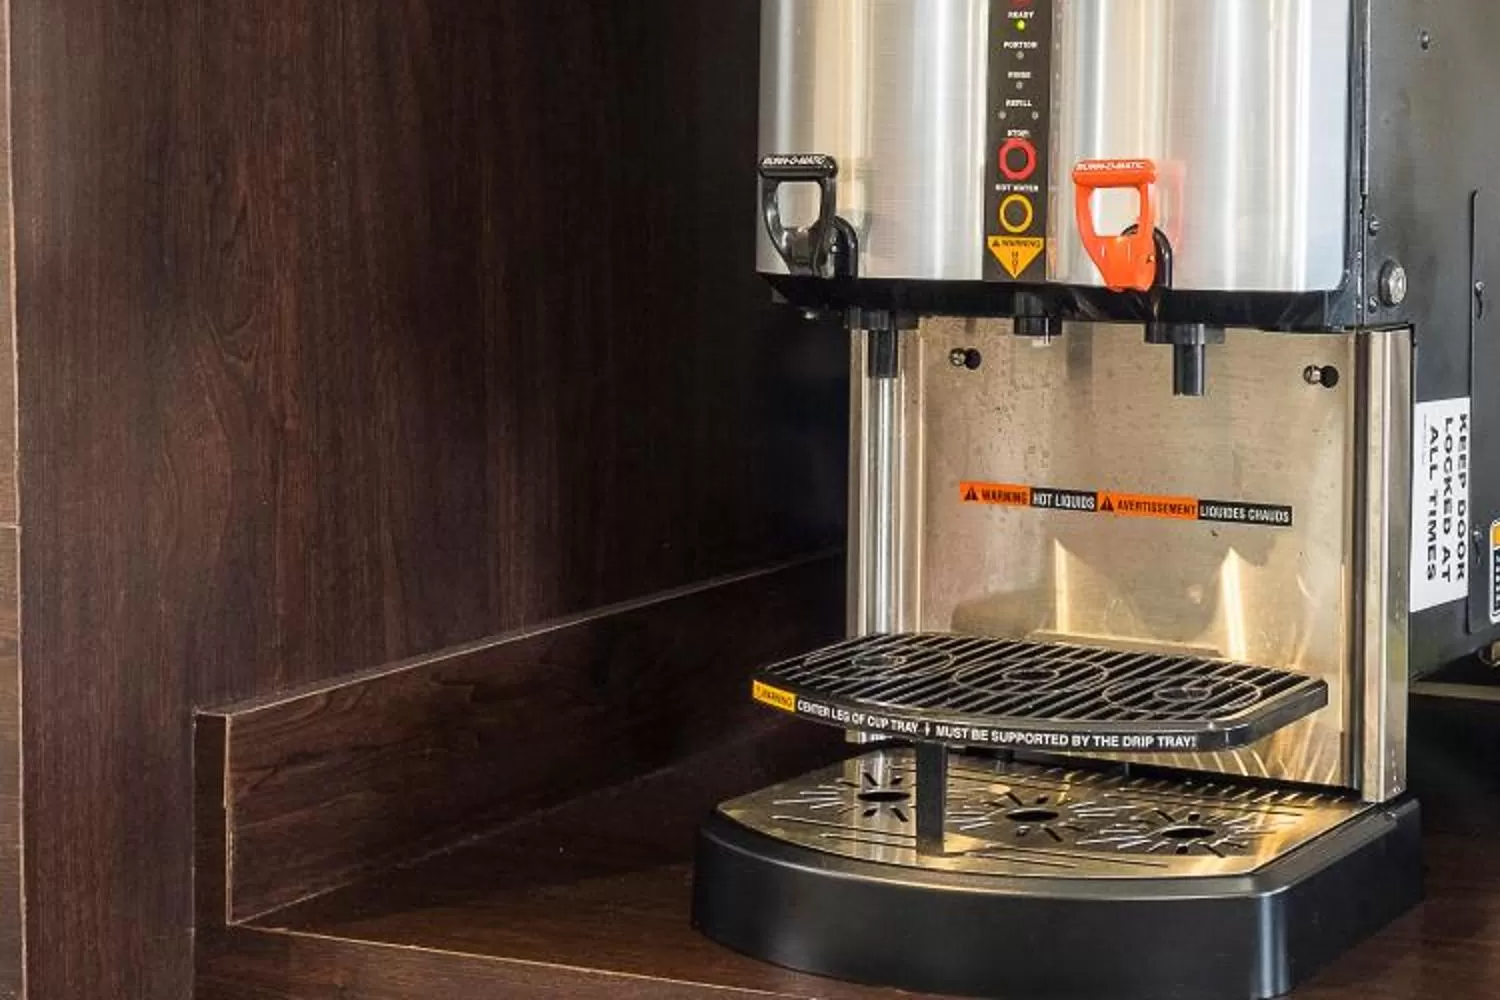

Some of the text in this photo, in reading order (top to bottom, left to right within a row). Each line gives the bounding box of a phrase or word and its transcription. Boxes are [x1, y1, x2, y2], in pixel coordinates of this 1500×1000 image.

[1007, 11, 1035, 19] READY
[1003, 41, 1038, 49] PORTION
[1005, 99, 1032, 107] REFILL
[1013, 184, 1039, 193] WATER
[1002, 239, 1040, 248] WARNING
[981, 488, 1290, 523] WARNING HOT LIQUIDS AVERTISSEMENT LIQUIDES CHAUDS
[1426, 426, 1439, 581] ALL TIMES
[1441, 417, 1453, 582] LOCKED AT
[1456, 413, 1468, 581] KEEP DOOR
[797, 699, 831, 718] CENTER
[831, 708, 850, 722] LEG
[851, 712, 866, 725] OF
[867, 715, 889, 729] CUP
[891, 719, 918, 733] TRAY
[935, 724, 969, 740] MUST
[971, 729, 988, 741] BE
[991, 730, 1068, 746] SUPPORTED
[1071, 735, 1089, 747] BY
[1092, 736, 1119, 747] THE
[1122, 736, 1154, 748] DRIP
